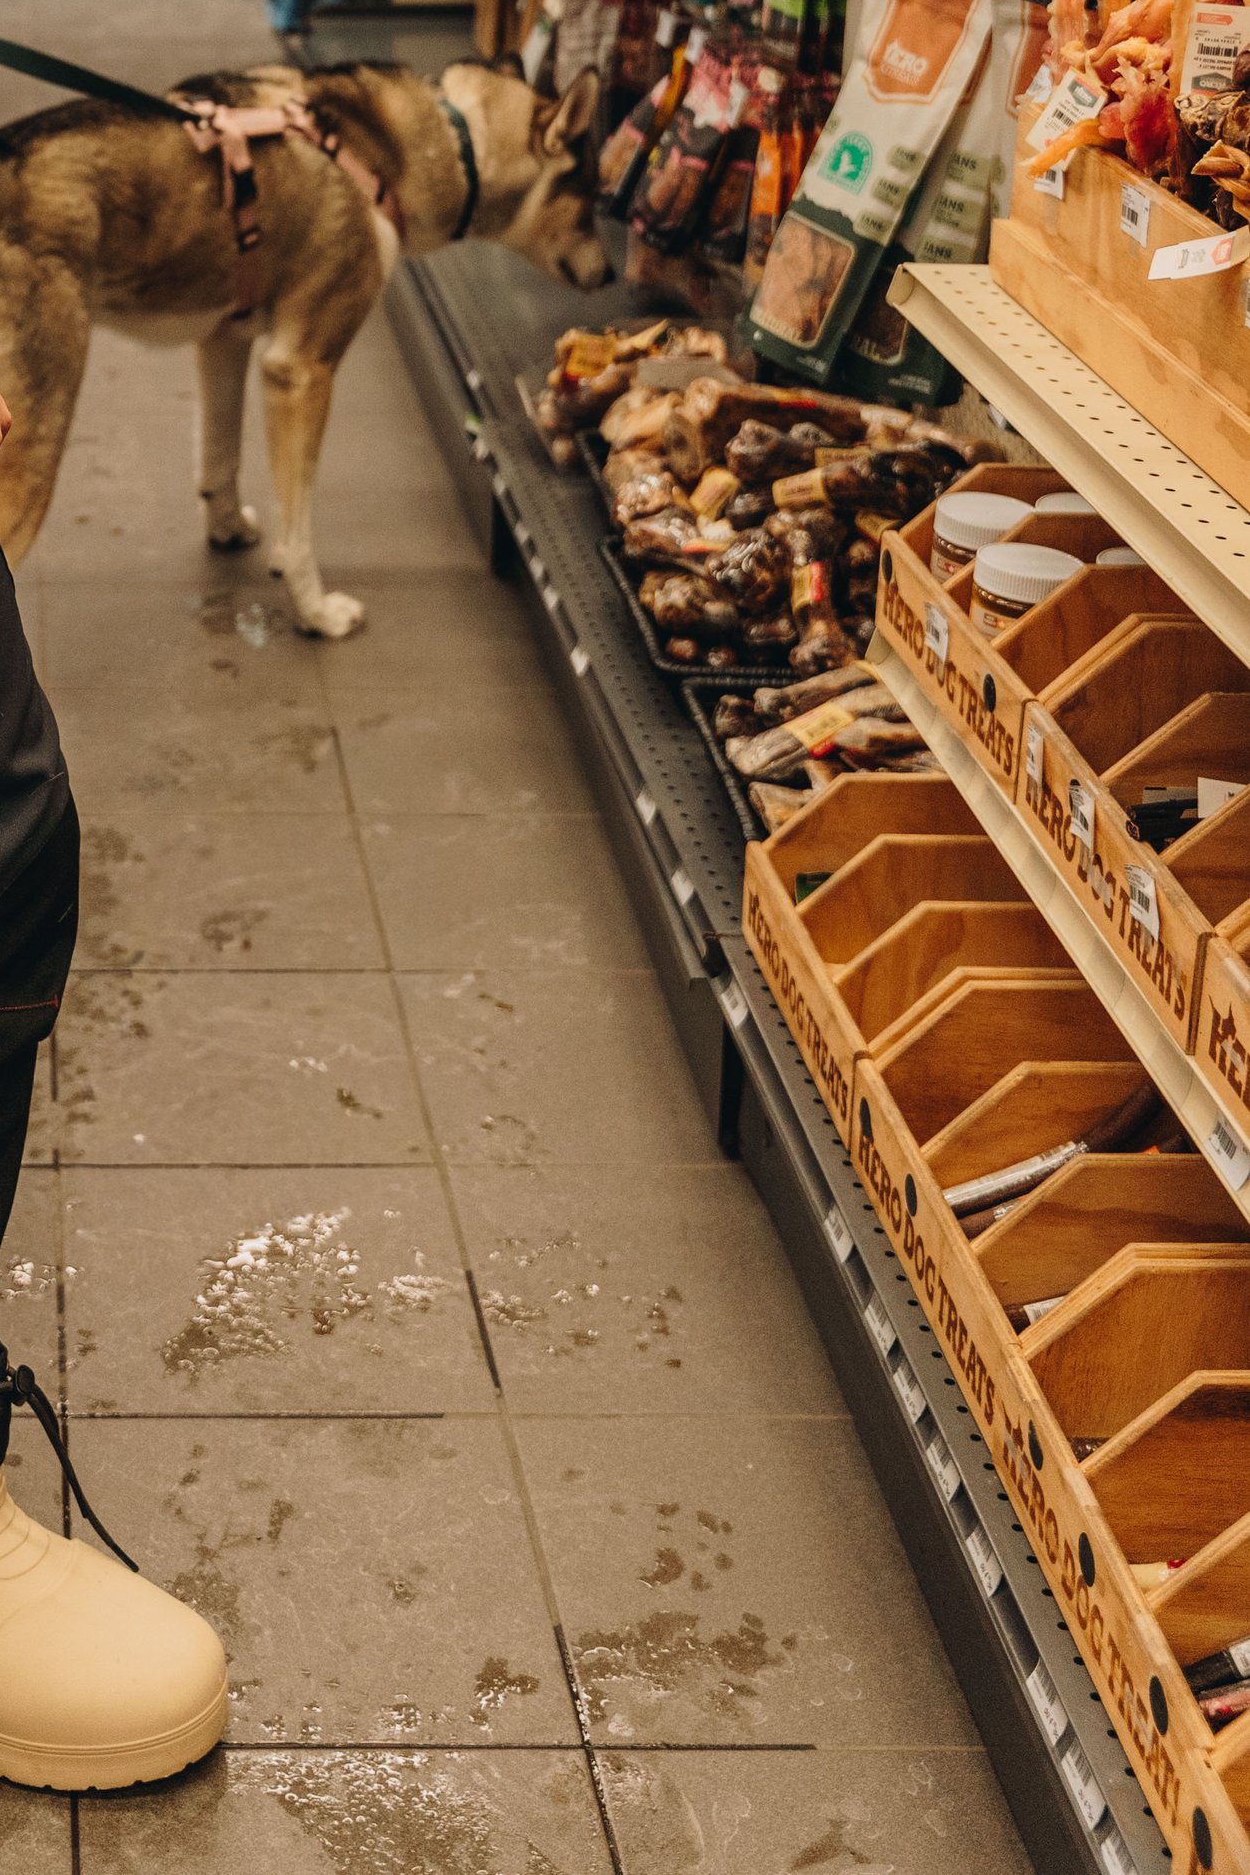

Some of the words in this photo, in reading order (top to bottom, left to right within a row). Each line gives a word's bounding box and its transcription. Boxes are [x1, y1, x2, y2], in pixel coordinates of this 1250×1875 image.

[958, 670, 1015, 777] TREATS
[749, 894, 780, 981] HERO
[781, 956, 805, 1033] DOG
[806, 1006, 849, 1123] TREATS
[1117, 884, 1186, 1022] TREATS
[858, 1132, 902, 1235] HERO
[904, 1209, 936, 1307] DOG
[937, 1272, 996, 1428] TREATS
[1061, 1537, 1105, 1668] DOG
